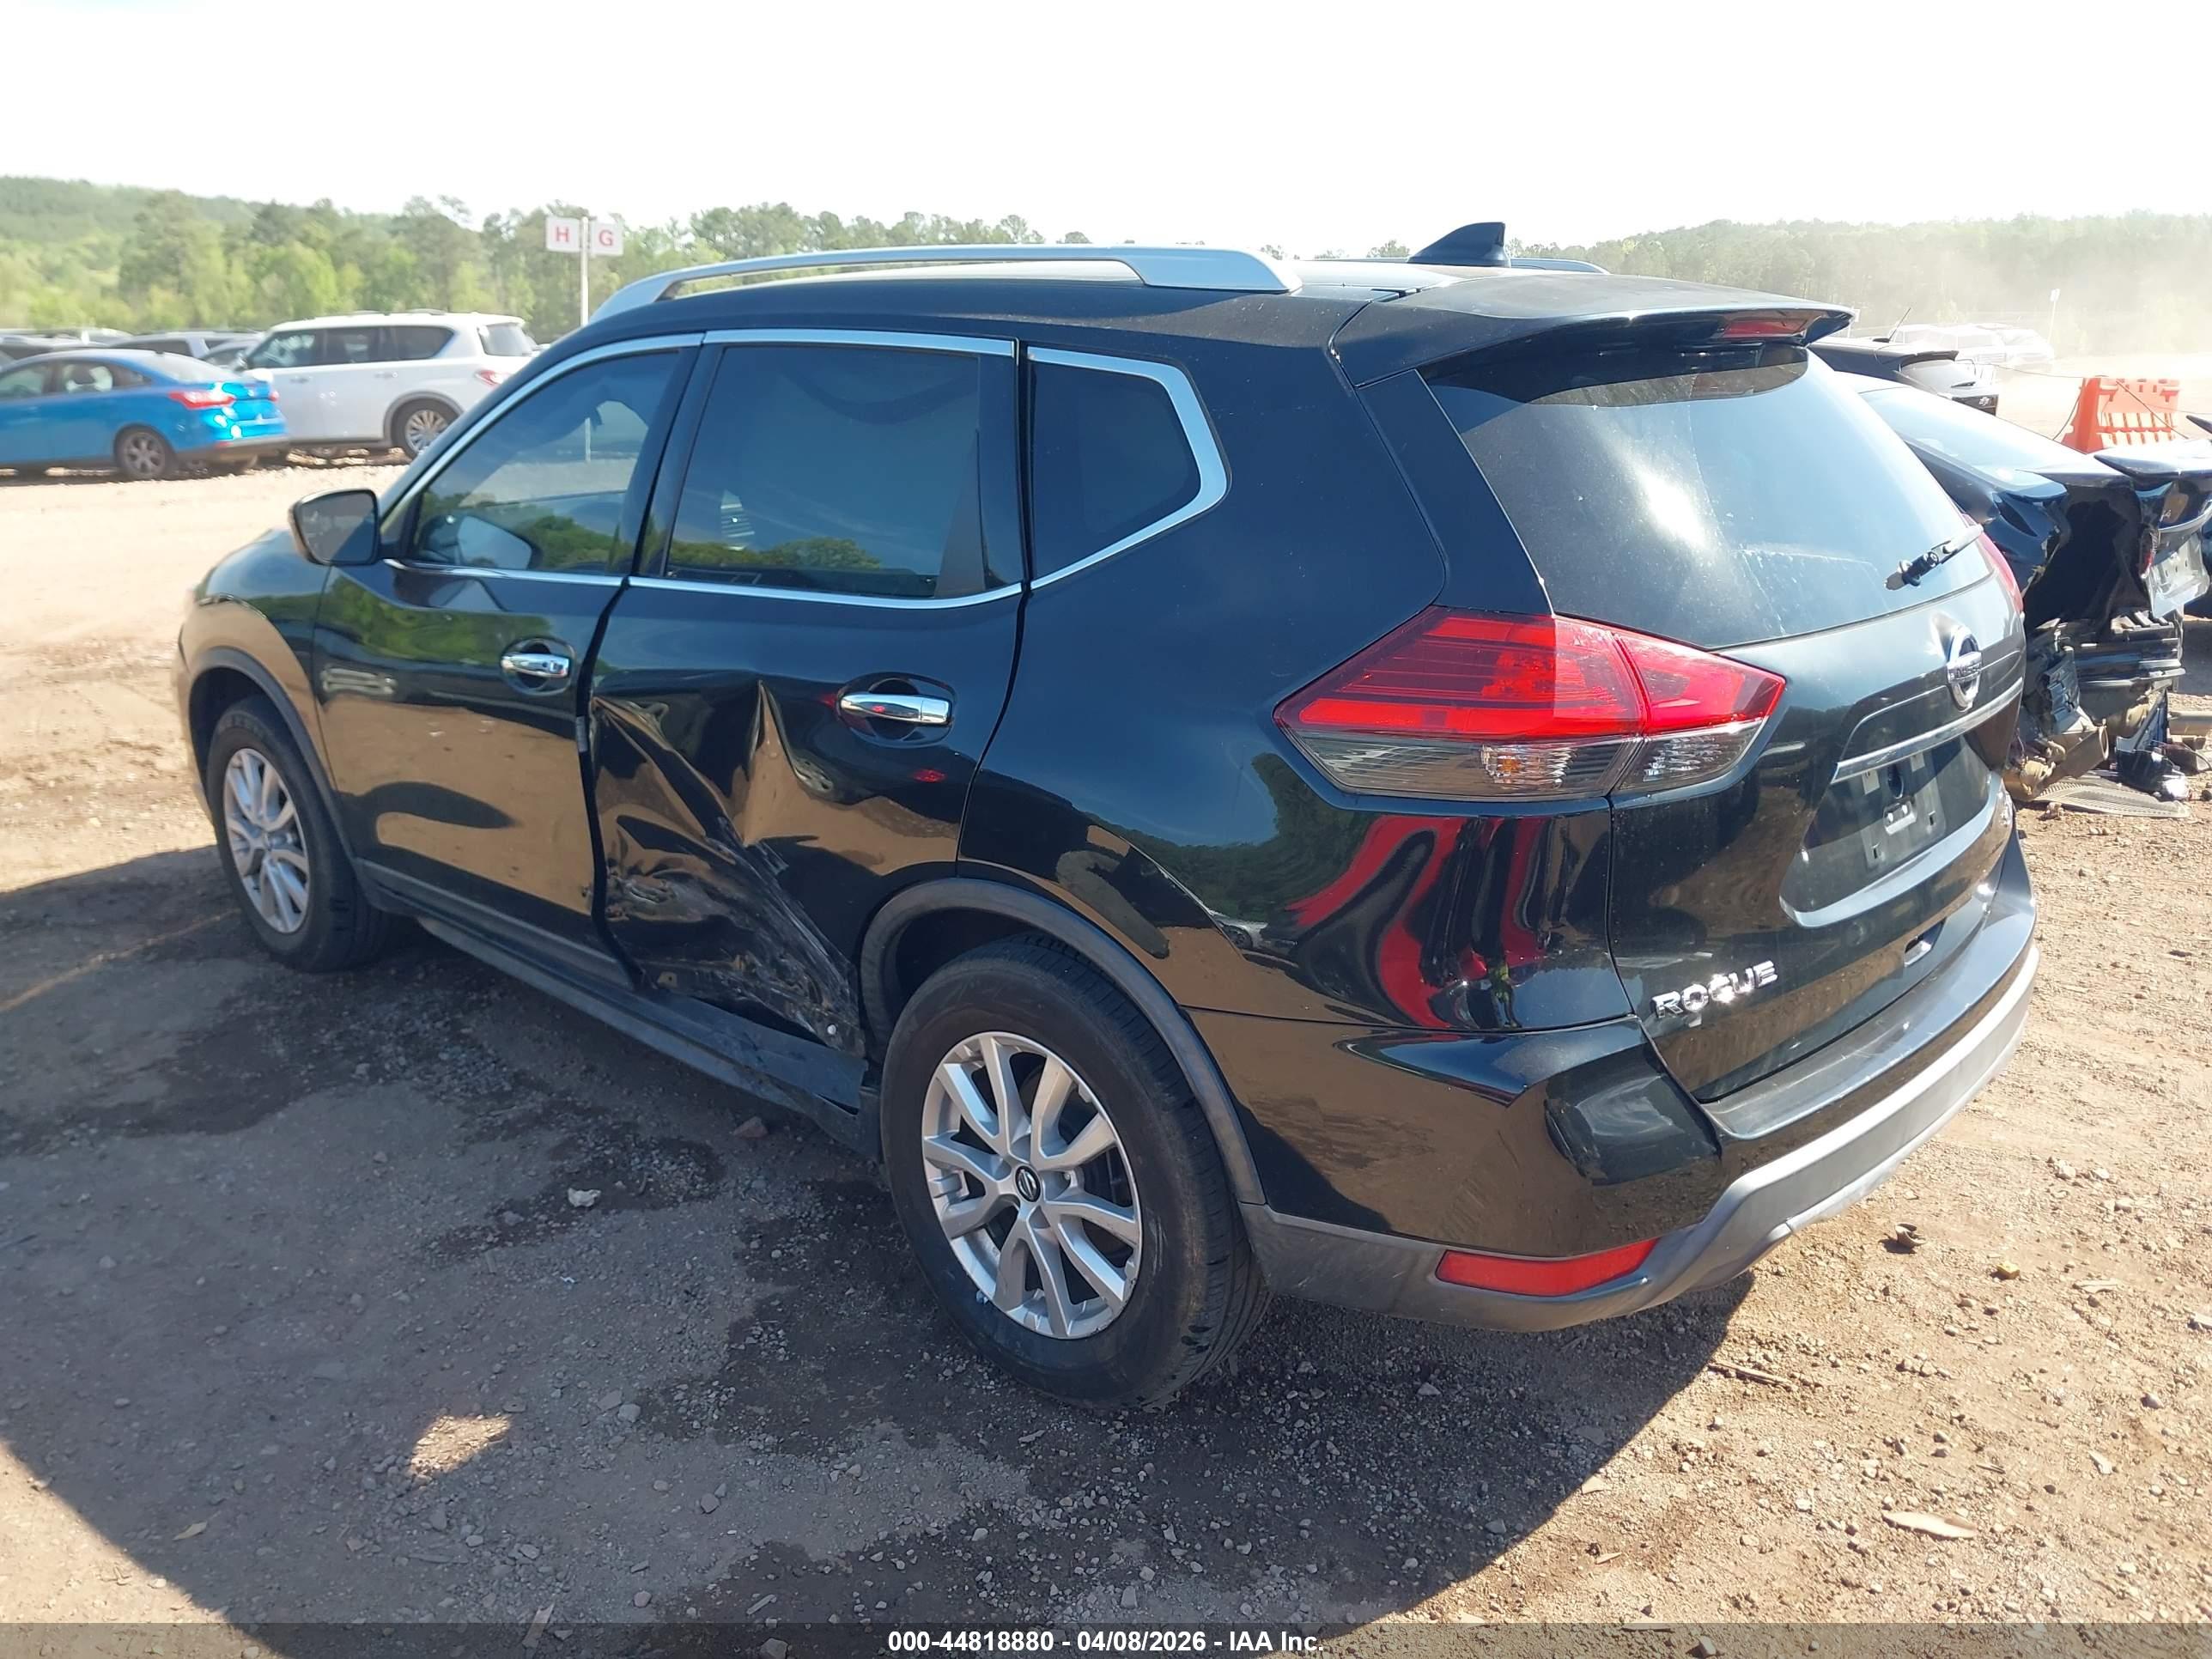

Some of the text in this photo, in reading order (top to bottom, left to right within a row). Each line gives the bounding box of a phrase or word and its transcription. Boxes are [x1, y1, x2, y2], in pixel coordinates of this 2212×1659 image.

[556, 226, 569, 242] H
[599, 229, 613, 246] G
[1650, 960, 1778, 1018] ROGUE
